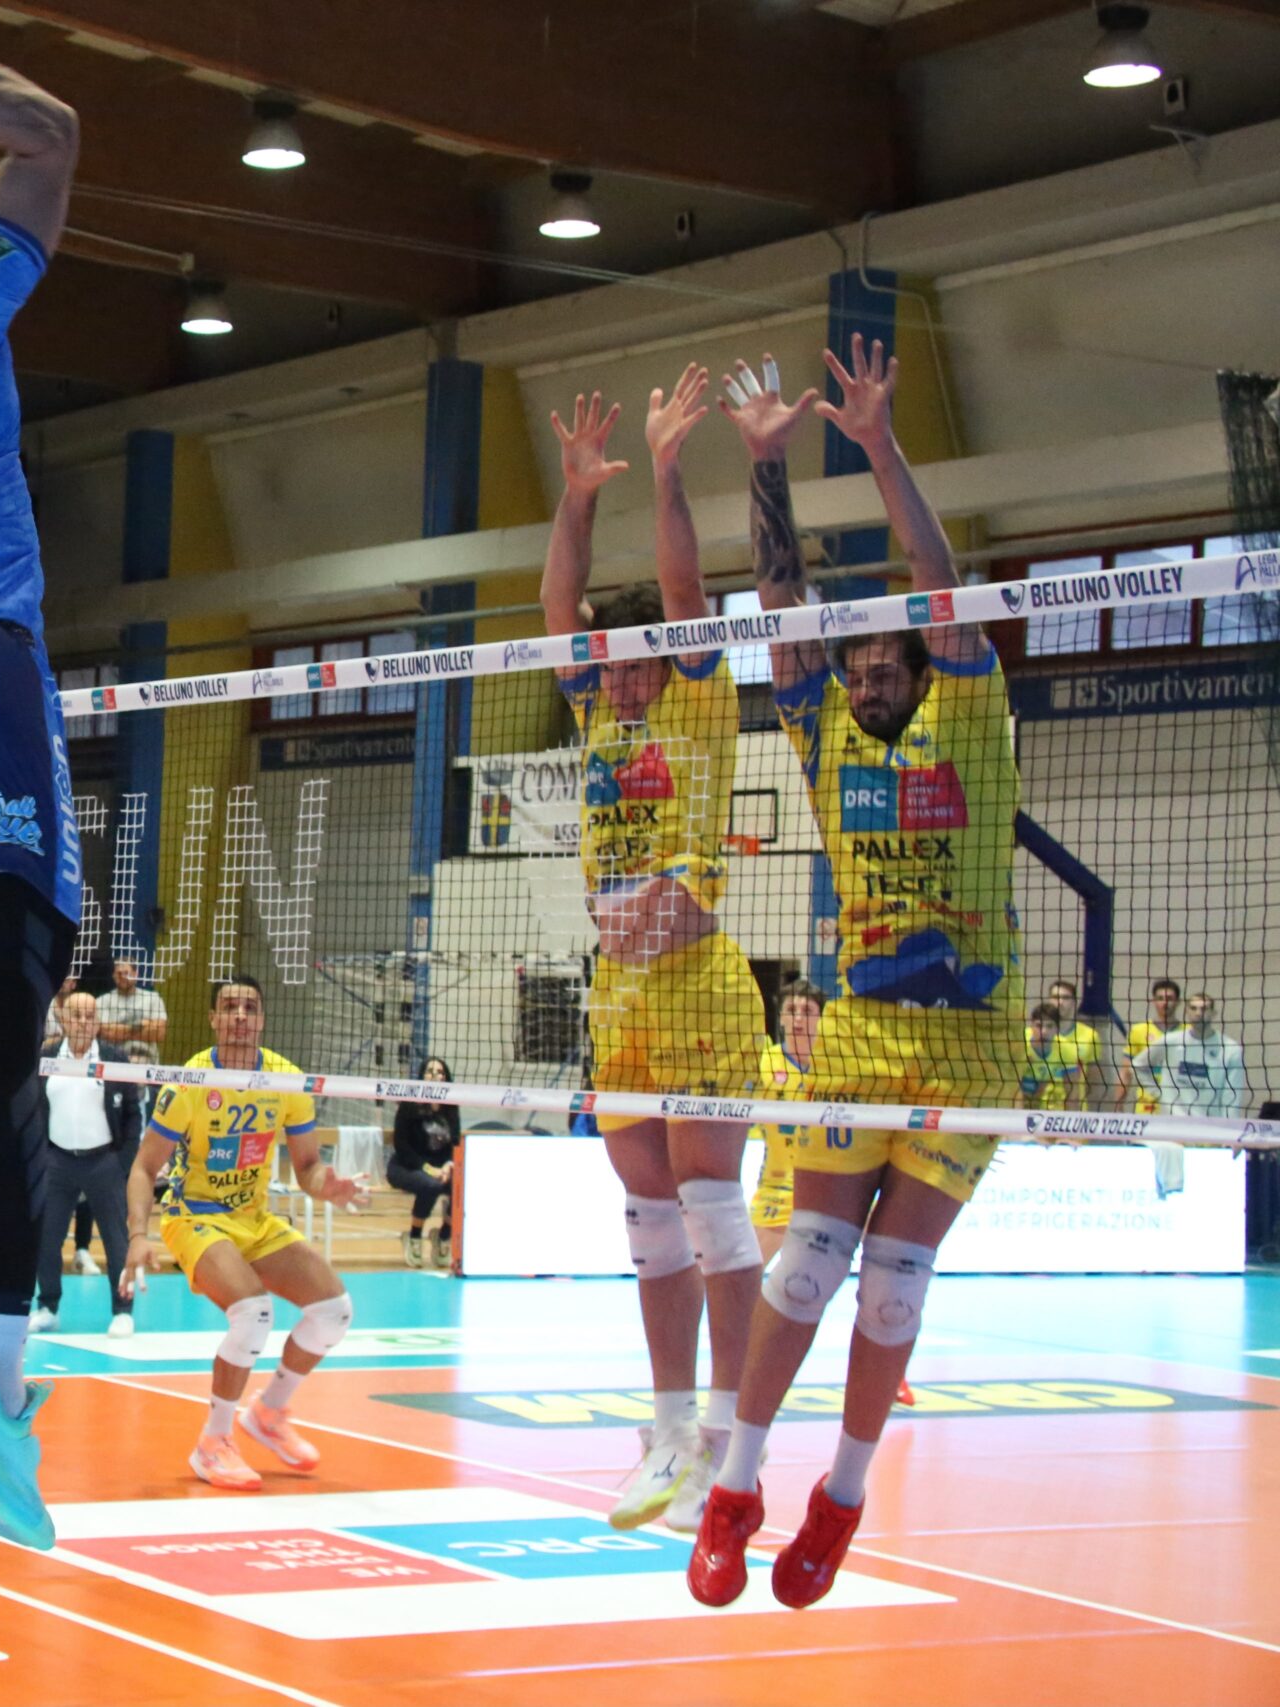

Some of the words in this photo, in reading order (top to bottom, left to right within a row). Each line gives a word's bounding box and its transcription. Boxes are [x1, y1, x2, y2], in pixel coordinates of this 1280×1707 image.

[1031, 575, 1110, 608] BELLUNO
[1114, 566, 1183, 598] VOLLEY
[666, 622, 727, 648] BELLUNO
[730, 614, 781, 640] VOLLEY
[383, 655, 431, 679] BELLUNO
[434, 650, 474, 673] VOLLEY
[154, 681, 193, 702] BELLUNO
[195, 677, 228, 698] VOLLEY
[1101, 671, 1280, 713] Sportivamen
[844, 788, 887, 809] DRC
[853, 837, 956, 861] PALLEX
[386, 1082, 420, 1098] BELLUNO
[420, 1084, 450, 1100] VOLLEY
[226, 1103, 259, 1135] 22
[674, 1100, 716, 1116] BELLUNO
[717, 1102, 754, 1118] VOLLEY
[1043, 1116, 1099, 1134] BELLUNO
[1101, 1118, 1148, 1136] VOLLEY
[473, 1383, 1175, 1424] CREDM
[448, 1535, 662, 1557] DRC
